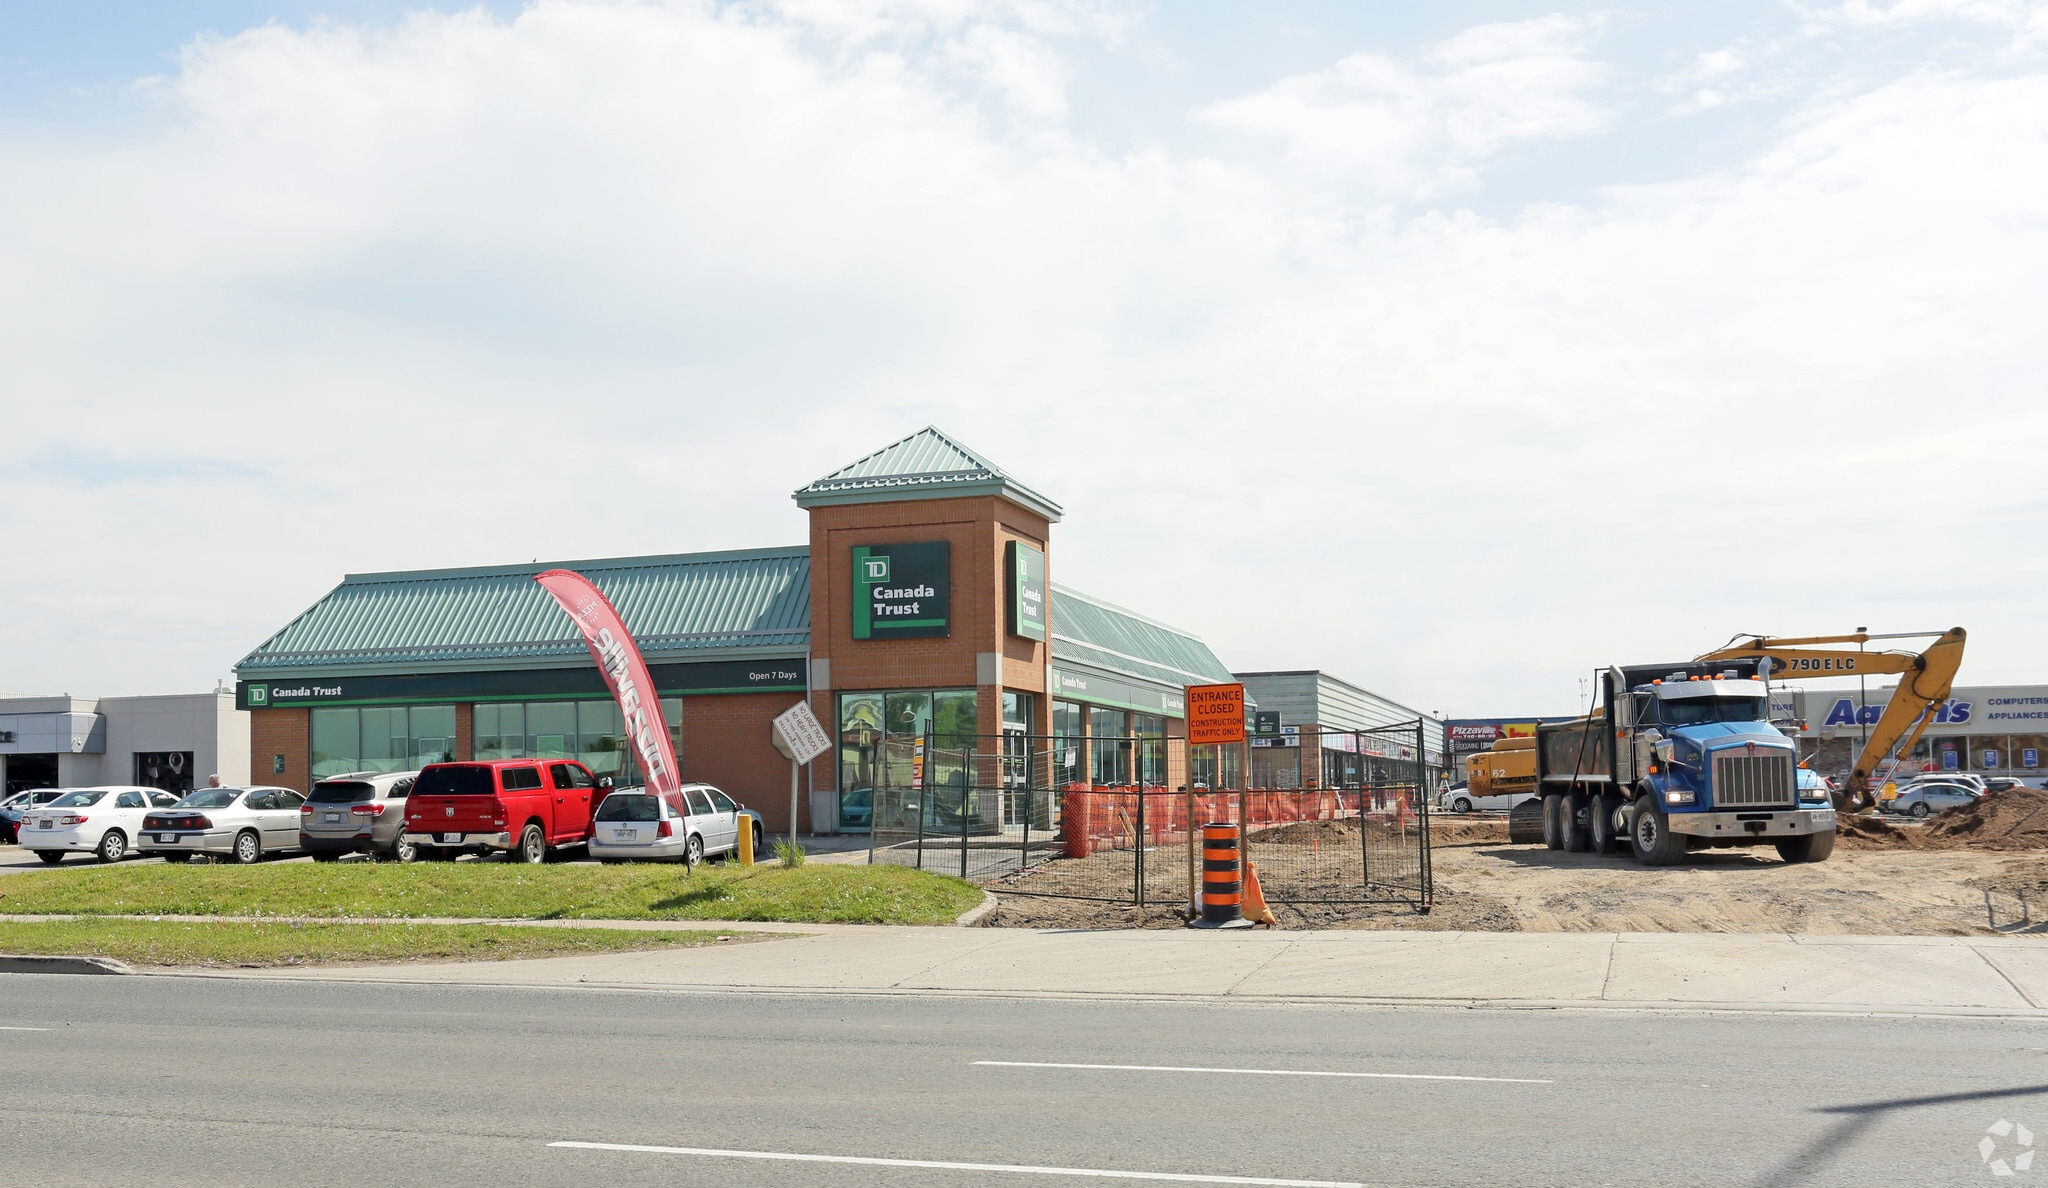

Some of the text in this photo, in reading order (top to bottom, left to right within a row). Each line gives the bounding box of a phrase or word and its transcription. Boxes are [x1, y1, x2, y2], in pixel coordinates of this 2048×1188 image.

[865, 561, 886, 578] TD
[873, 584, 935, 599] Canada
[1022, 586, 1041, 603] Canada
[873, 602, 920, 616] Trust
[1022, 601, 1037, 617] Trust
[749, 672, 770, 681] Open
[778, 671, 797, 680] Days
[1062, 676, 1076, 687] Canada
[1076, 679, 1087, 690] Trust
[250, 686, 342, 701] TD Canada Trust
[1191, 690, 1241, 702] ENTRANCE
[1988, 697, 2048, 705] COMPUTERS
[1198, 703, 1234, 714] CLOSED
[1191, 718, 1242, 728] CONSTRUCTION
[1988, 712, 2048, 720] APPLIANCES
[790, 711, 819, 752] NO HEAVY TRUCKS
[799, 706, 827, 746] NO LARGE TRUCKS
[1193, 729, 1220, 737] TRAFFIC
[778, 720, 805, 760] DELIVERIES ONLY
[1492, 769, 1506, 777] 62
